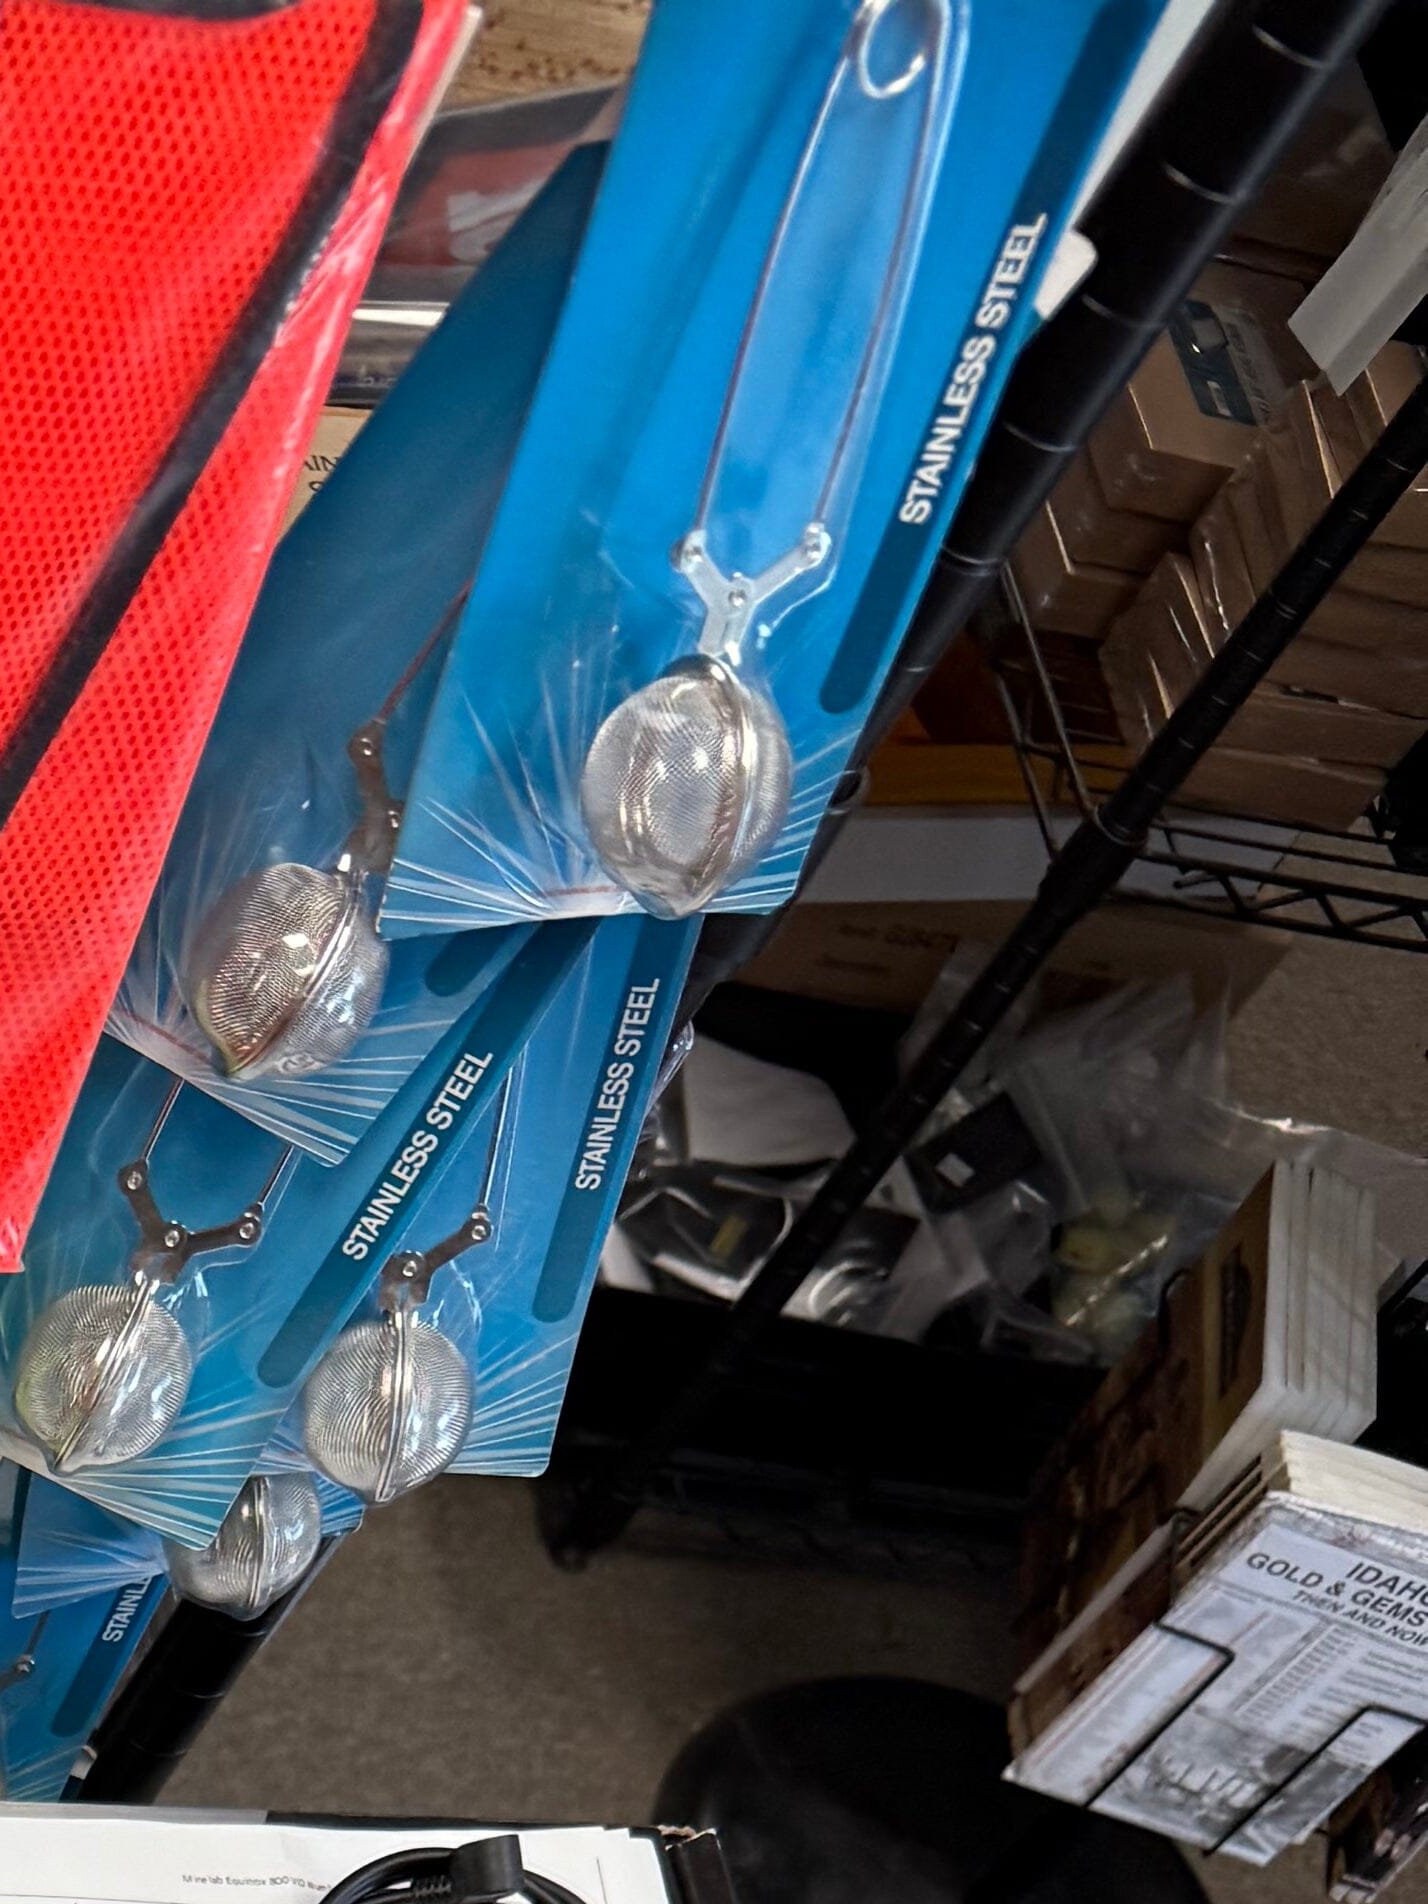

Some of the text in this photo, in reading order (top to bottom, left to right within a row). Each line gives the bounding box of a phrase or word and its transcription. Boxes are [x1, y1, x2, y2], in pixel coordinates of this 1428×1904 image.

[899, 211, 1048, 525] STAINLESS STEEL
[341, 1051, 494, 1261] STAINLESS STEEL
[575, 977, 660, 1191] STAINLESS STEEL
[1246, 1552, 1428, 1627] GOLD & GEMS
[1344, 1609, 1386, 1630] AND
